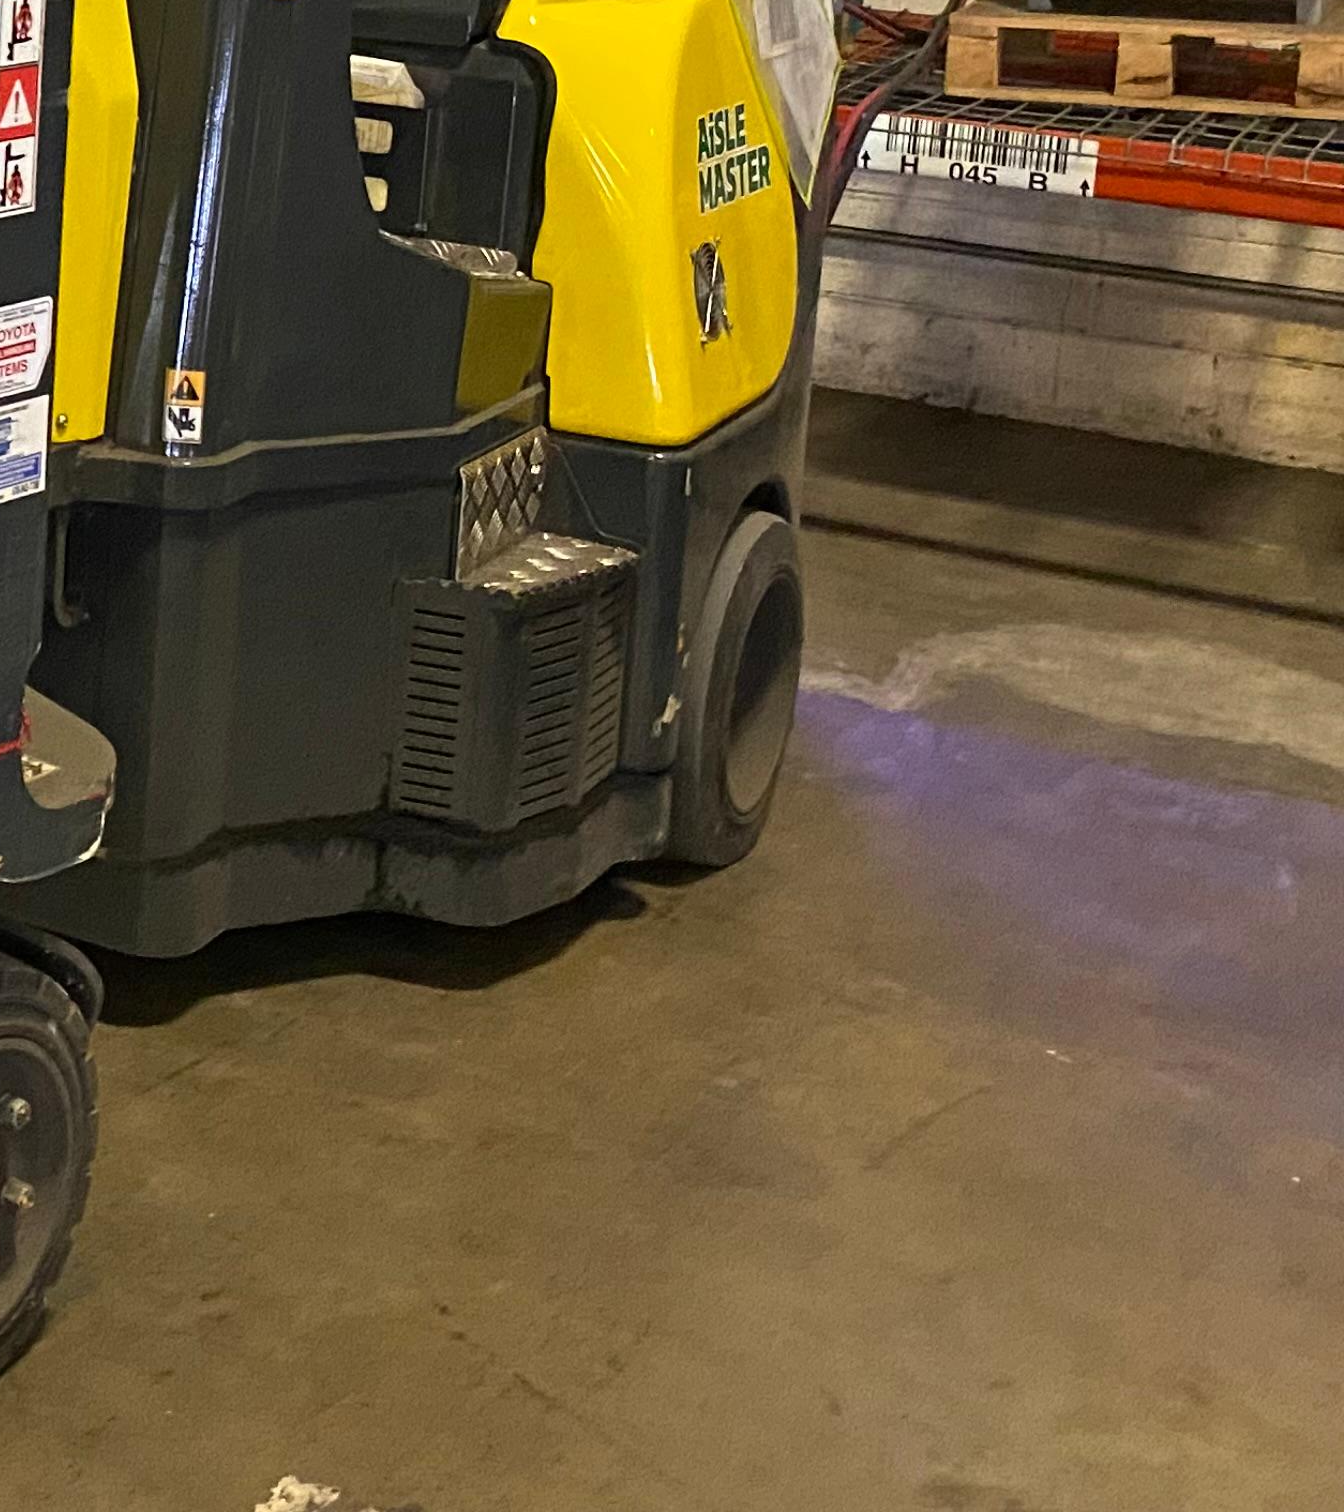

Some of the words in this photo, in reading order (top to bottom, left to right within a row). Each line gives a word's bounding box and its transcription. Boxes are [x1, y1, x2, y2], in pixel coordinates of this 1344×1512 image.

[699, 146, 771, 213] MASTER
[900, 155, 919, 175] H
[949, 162, 998, 186] 045
[1028, 171, 1048, 192] B
